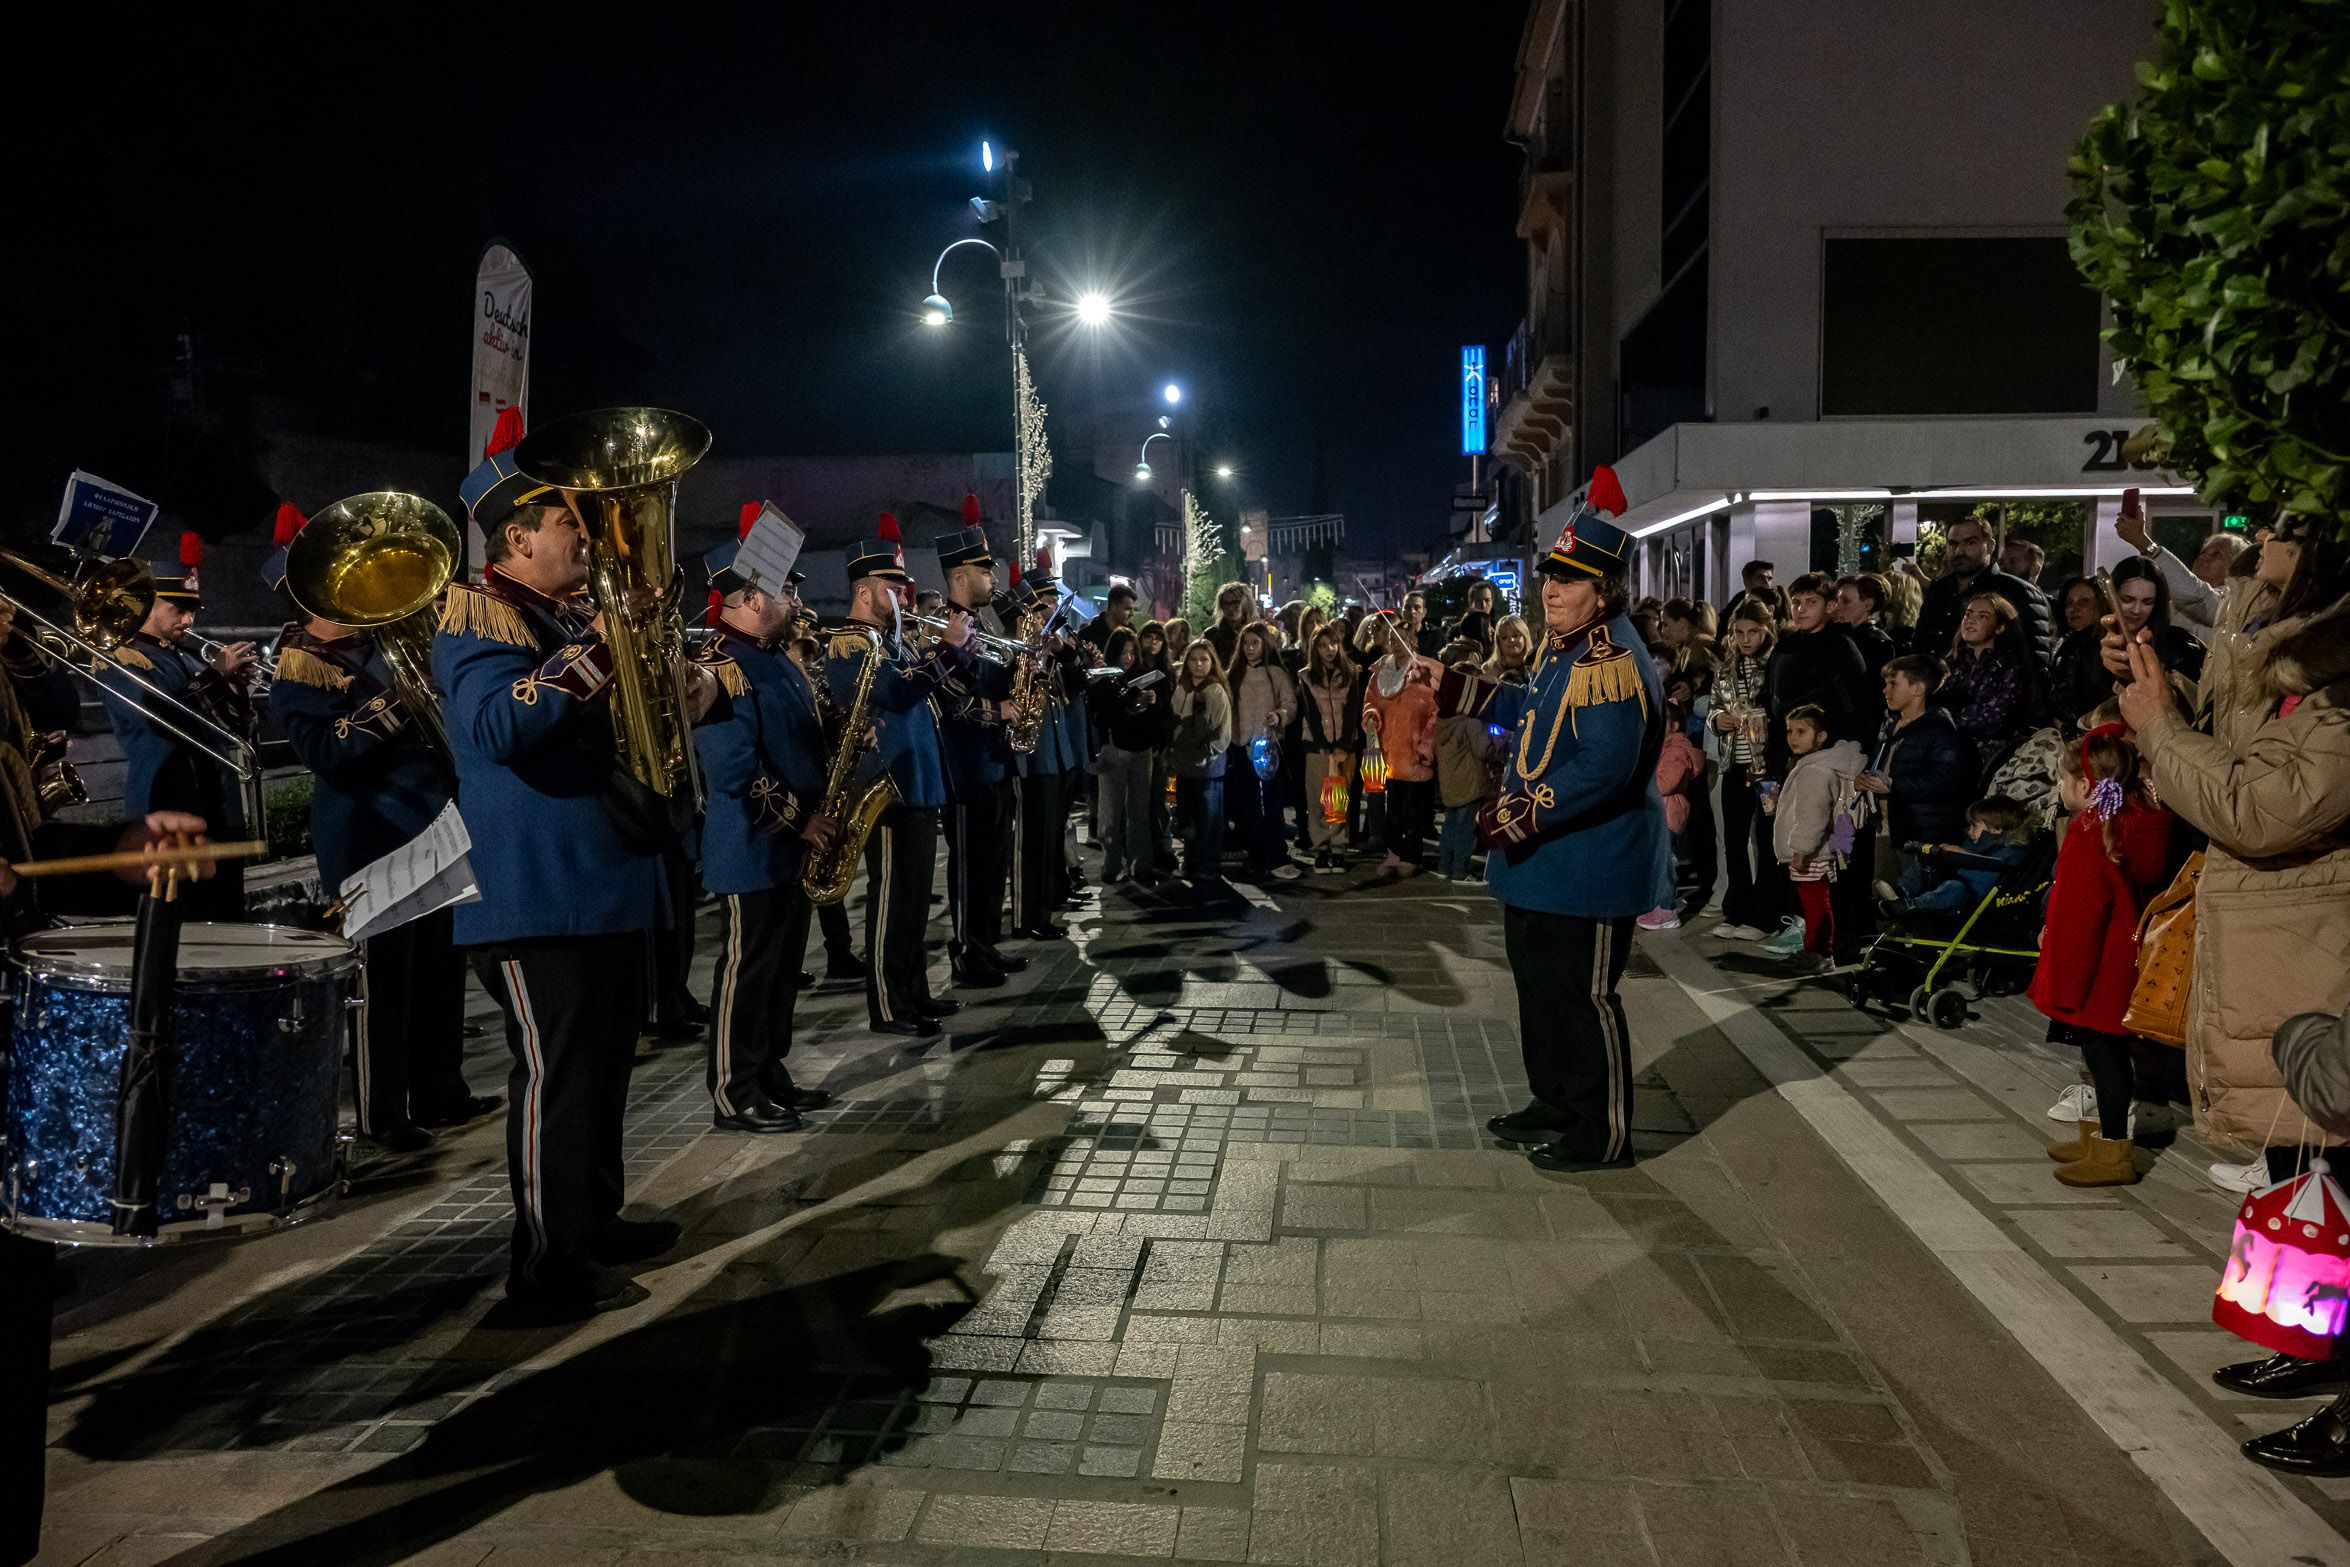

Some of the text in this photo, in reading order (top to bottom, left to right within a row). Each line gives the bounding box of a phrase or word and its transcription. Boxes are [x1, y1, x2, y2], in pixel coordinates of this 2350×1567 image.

[484, 291, 528, 338] Deutsch
[483, 322, 522, 361] aktiv in
